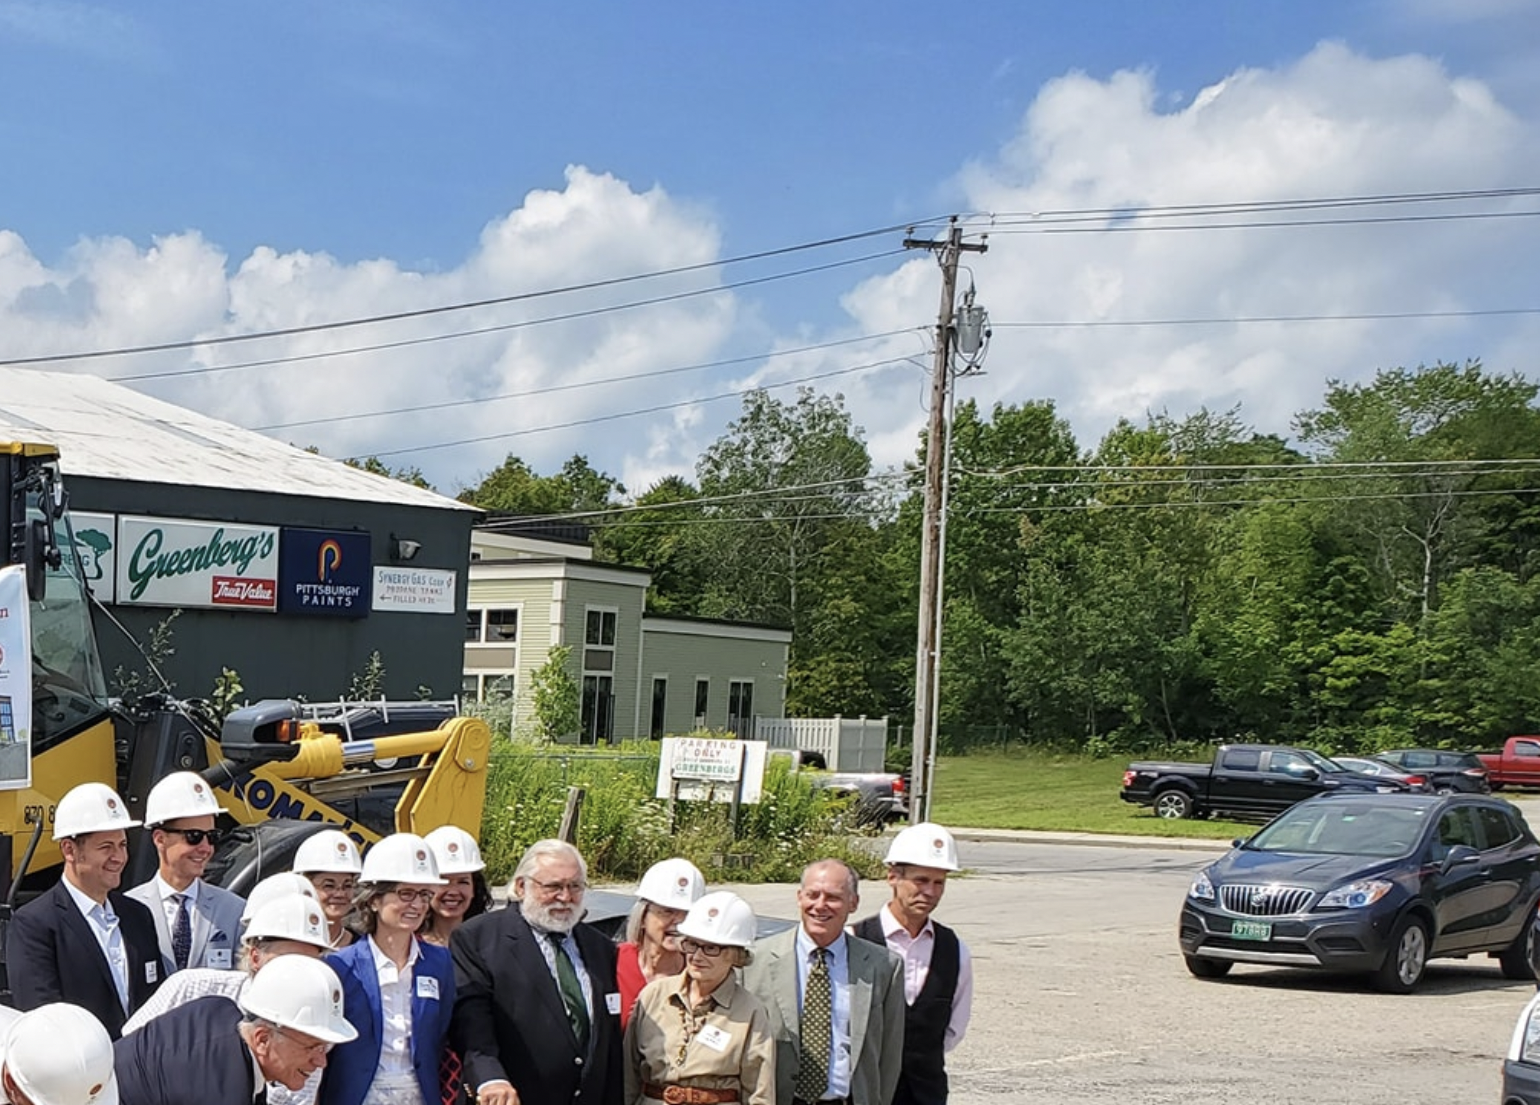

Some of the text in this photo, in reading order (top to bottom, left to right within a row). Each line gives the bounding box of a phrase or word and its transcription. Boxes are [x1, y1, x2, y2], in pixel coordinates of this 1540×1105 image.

[128, 527, 275, 601] Greenberg's
[296, 583, 361, 597] PITTSBURGH
[302, 594, 352, 607] PAINTS
[680, 740, 737, 750] PARKING
[694, 748, 722, 757] ONLY
